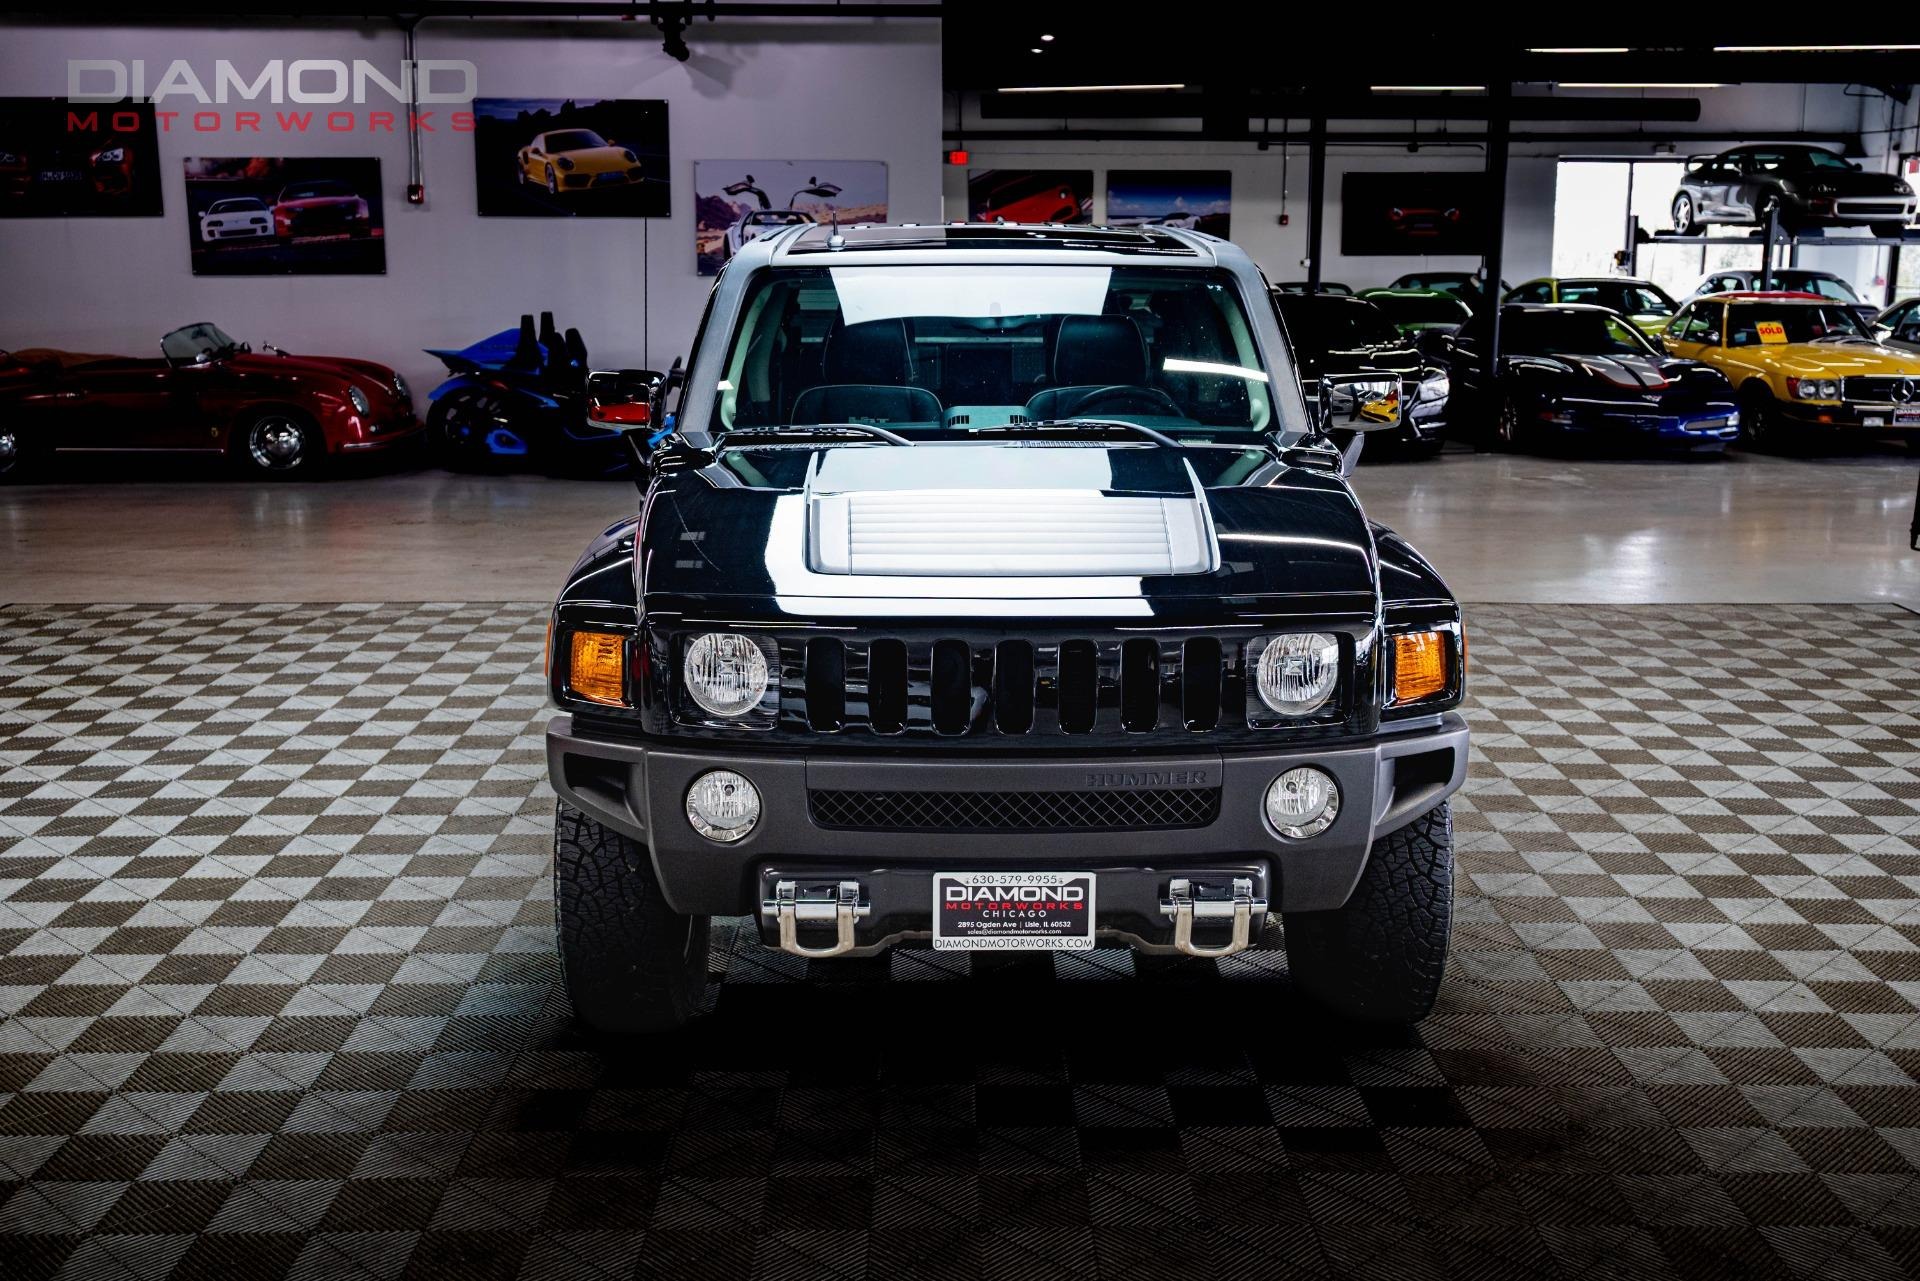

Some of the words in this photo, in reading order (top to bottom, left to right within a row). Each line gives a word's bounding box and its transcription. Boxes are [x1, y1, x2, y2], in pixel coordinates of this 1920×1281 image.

[1759, 326, 1783, 336] SOLD
[1086, 771, 1207, 787] HUMMER
[972, 875, 1057, 885] 630-579-9955
[946, 886, 1084, 902] DIAMOND
[945, 902, 1083, 910] MOTORWORKS
[983, 910, 1047, 918] CHICAGO
[976, 921, 1001, 929] Ogden
[934, 939, 1093, 949] DIAMONDMOTORWORKS.COM
